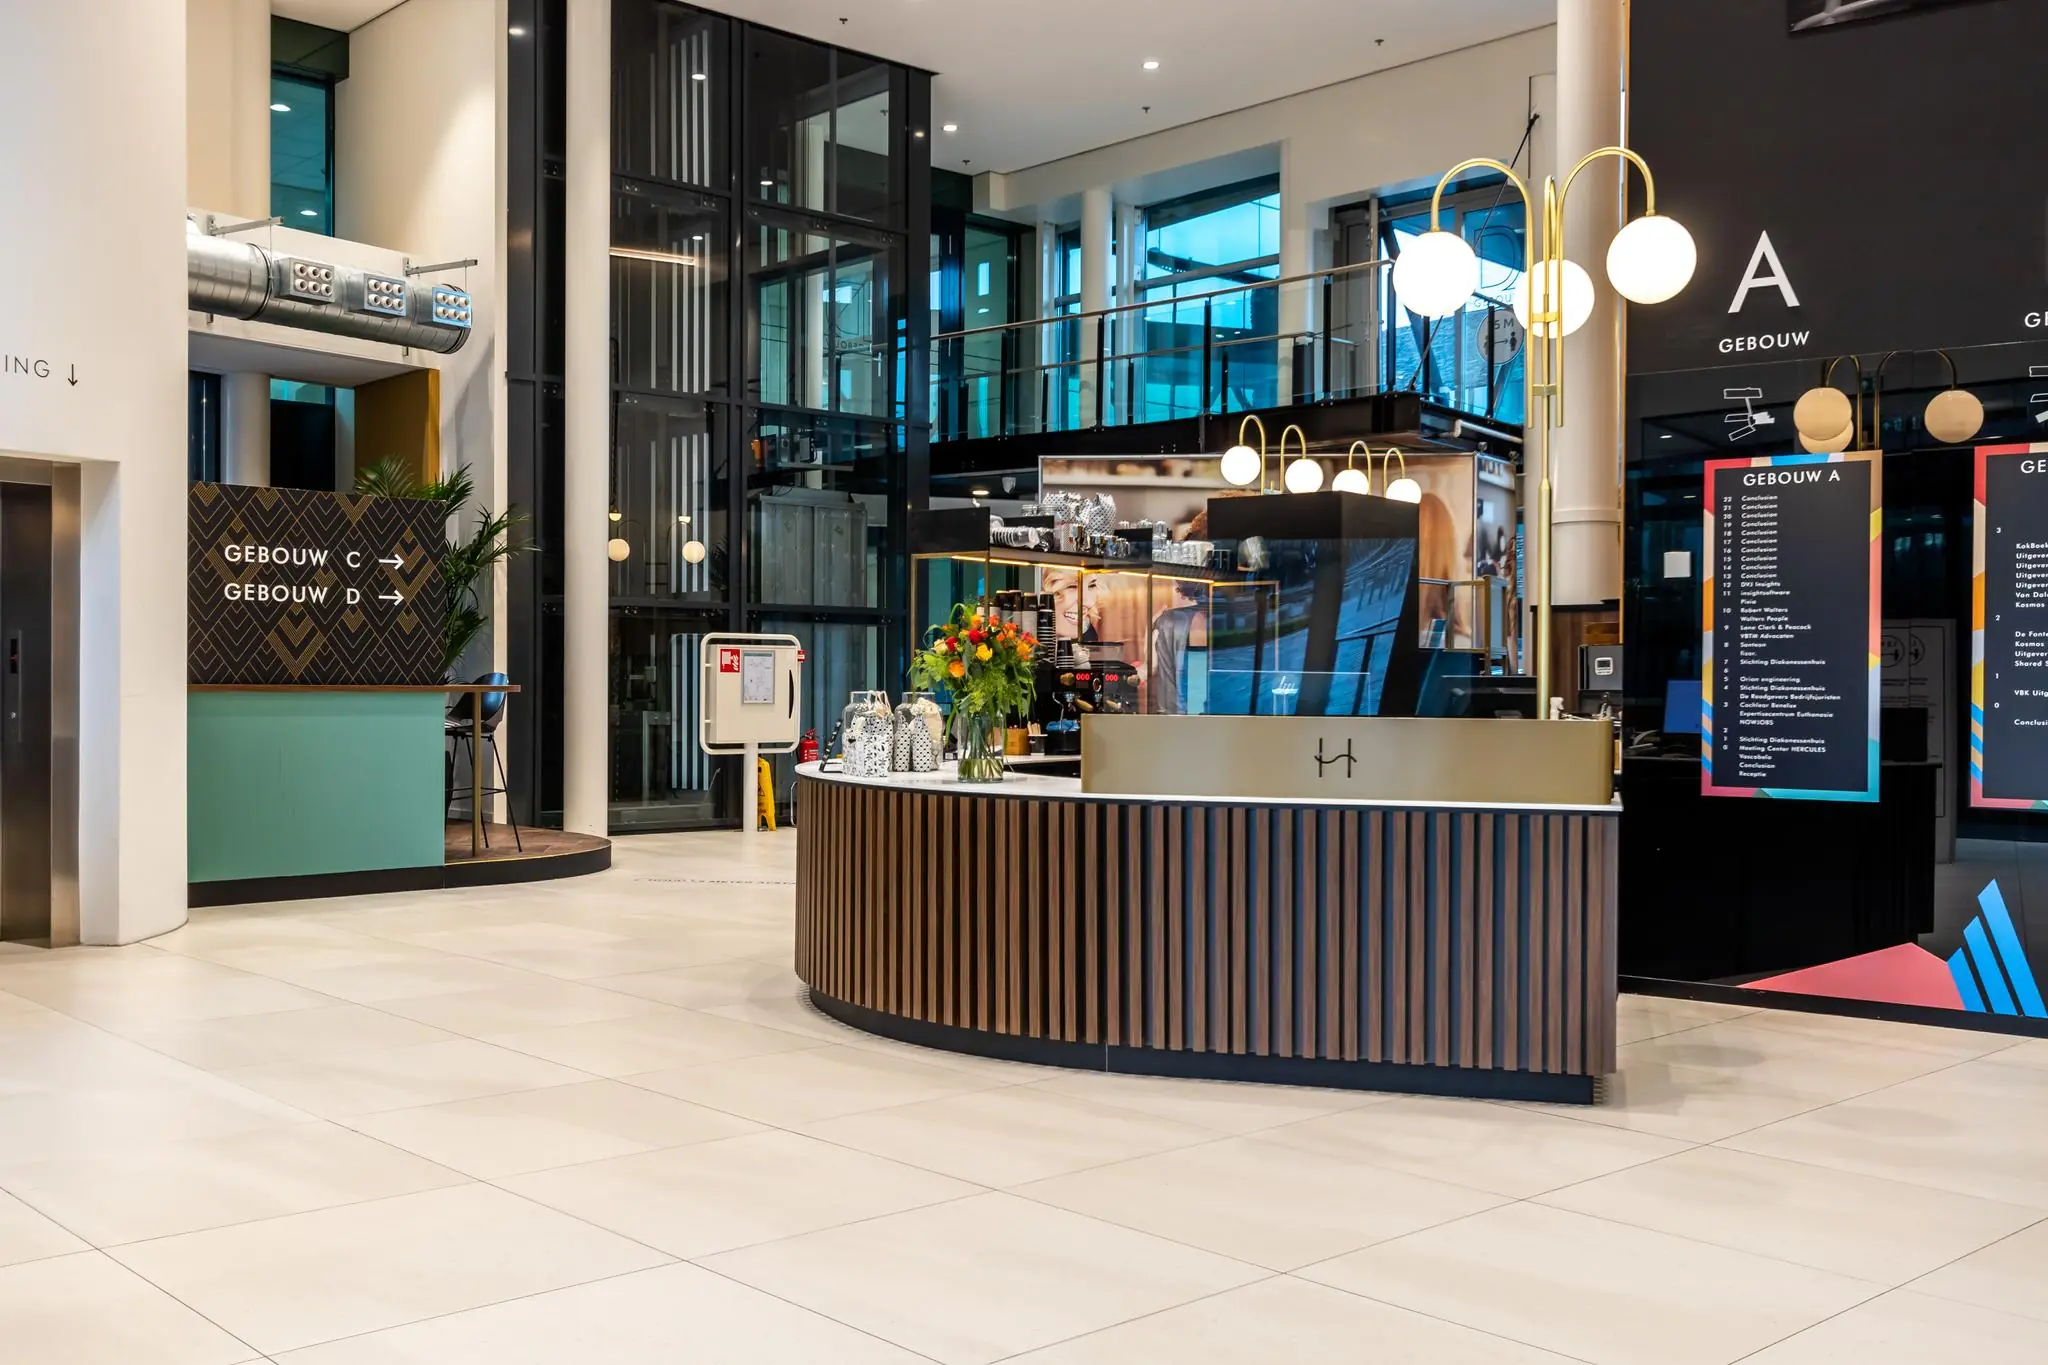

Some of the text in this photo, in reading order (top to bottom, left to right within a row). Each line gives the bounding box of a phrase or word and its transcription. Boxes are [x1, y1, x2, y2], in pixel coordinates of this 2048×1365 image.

[1727, 230, 1800, 314] A
[1718, 330, 1810, 353] GEBOUW
[5, 354, 50, 378] ING
[1743, 469, 1841, 487] GEBOUW A
[1741, 503, 1778, 511] Conclusion
[1741, 520, 1778, 528] Conclusion
[1995, 526, 2002, 534] 3
[1740, 546, 1778, 554] Conclusion
[224, 544, 361, 568] GEBOUW C
[1740, 563, 1778, 571] Conclusion
[224, 582, 361, 605] GEBOUW D
[1740, 589, 1791, 597] insightsoftware
[2015, 591, 2031, 599] Van
[2015, 601, 2046, 609] Kosmos
[1784, 623, 1812, 631] Peacock
[2014, 630, 2026, 638] De
[2014, 640, 2045, 648] Kosmos
[1739, 658, 1770, 666] Stichting
[2014, 659, 2043, 667] Shared
[1760, 676, 1801, 684] engineering
[1739, 684, 1769, 692] Stichting
[1769, 684, 1826, 692] Diakonessenhuis
[1789, 693, 1841, 701] Bedrijfsjuristen
[2013, 689, 2030, 697] VBK
[1993, 701, 2000, 709] 0
[1739, 710, 1795, 718] Expertisecentrum
[2013, 718, 2048, 726] Conclusi
[1739, 736, 1768, 744] Stichting
[1769, 736, 1825, 744] Diakonessenhuis
[1739, 745, 1766, 753] Meeting
[1738, 761, 1776, 769] Conclusion
[1738, 770, 1767, 778] Receptie
